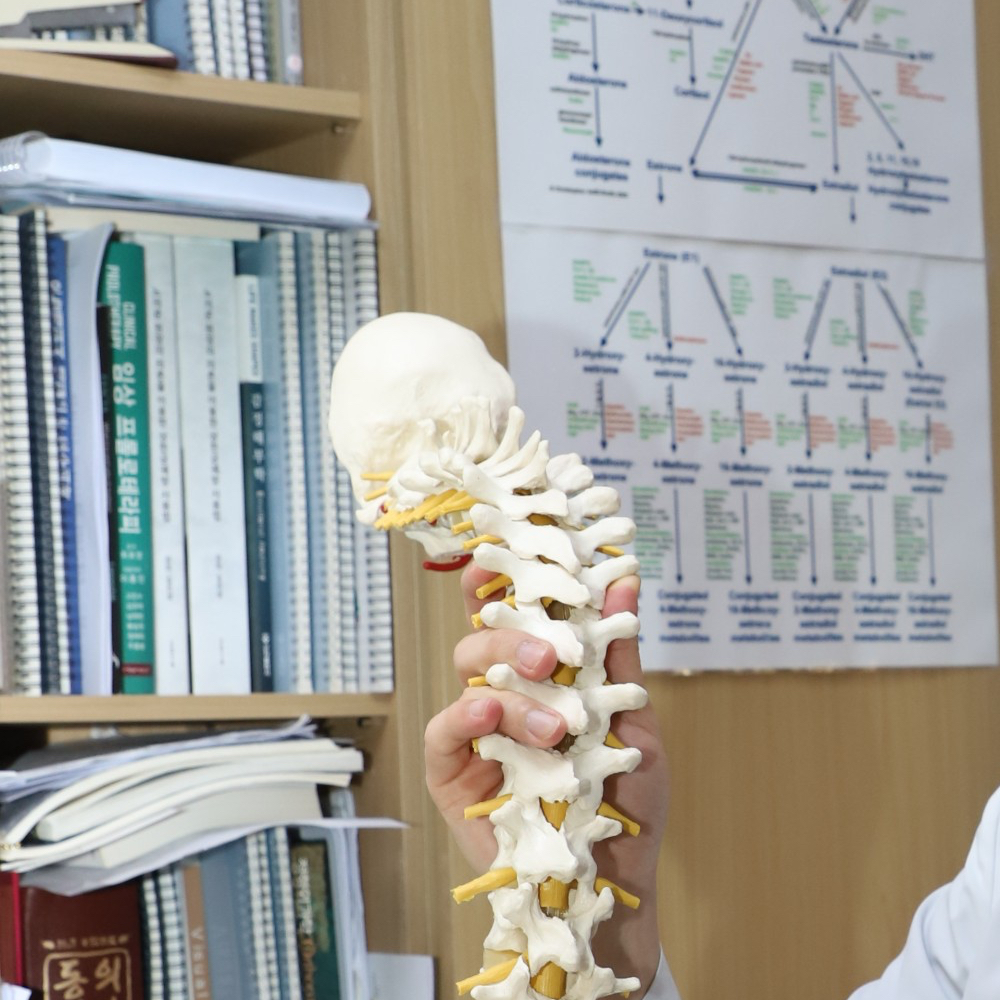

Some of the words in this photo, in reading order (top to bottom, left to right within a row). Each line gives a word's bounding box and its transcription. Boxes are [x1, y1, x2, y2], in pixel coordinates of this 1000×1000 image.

[112, 362, 137, 407] 임상
[115, 418, 141, 535] 프롤로테라피
[189, 925, 208, 1000] Visual
